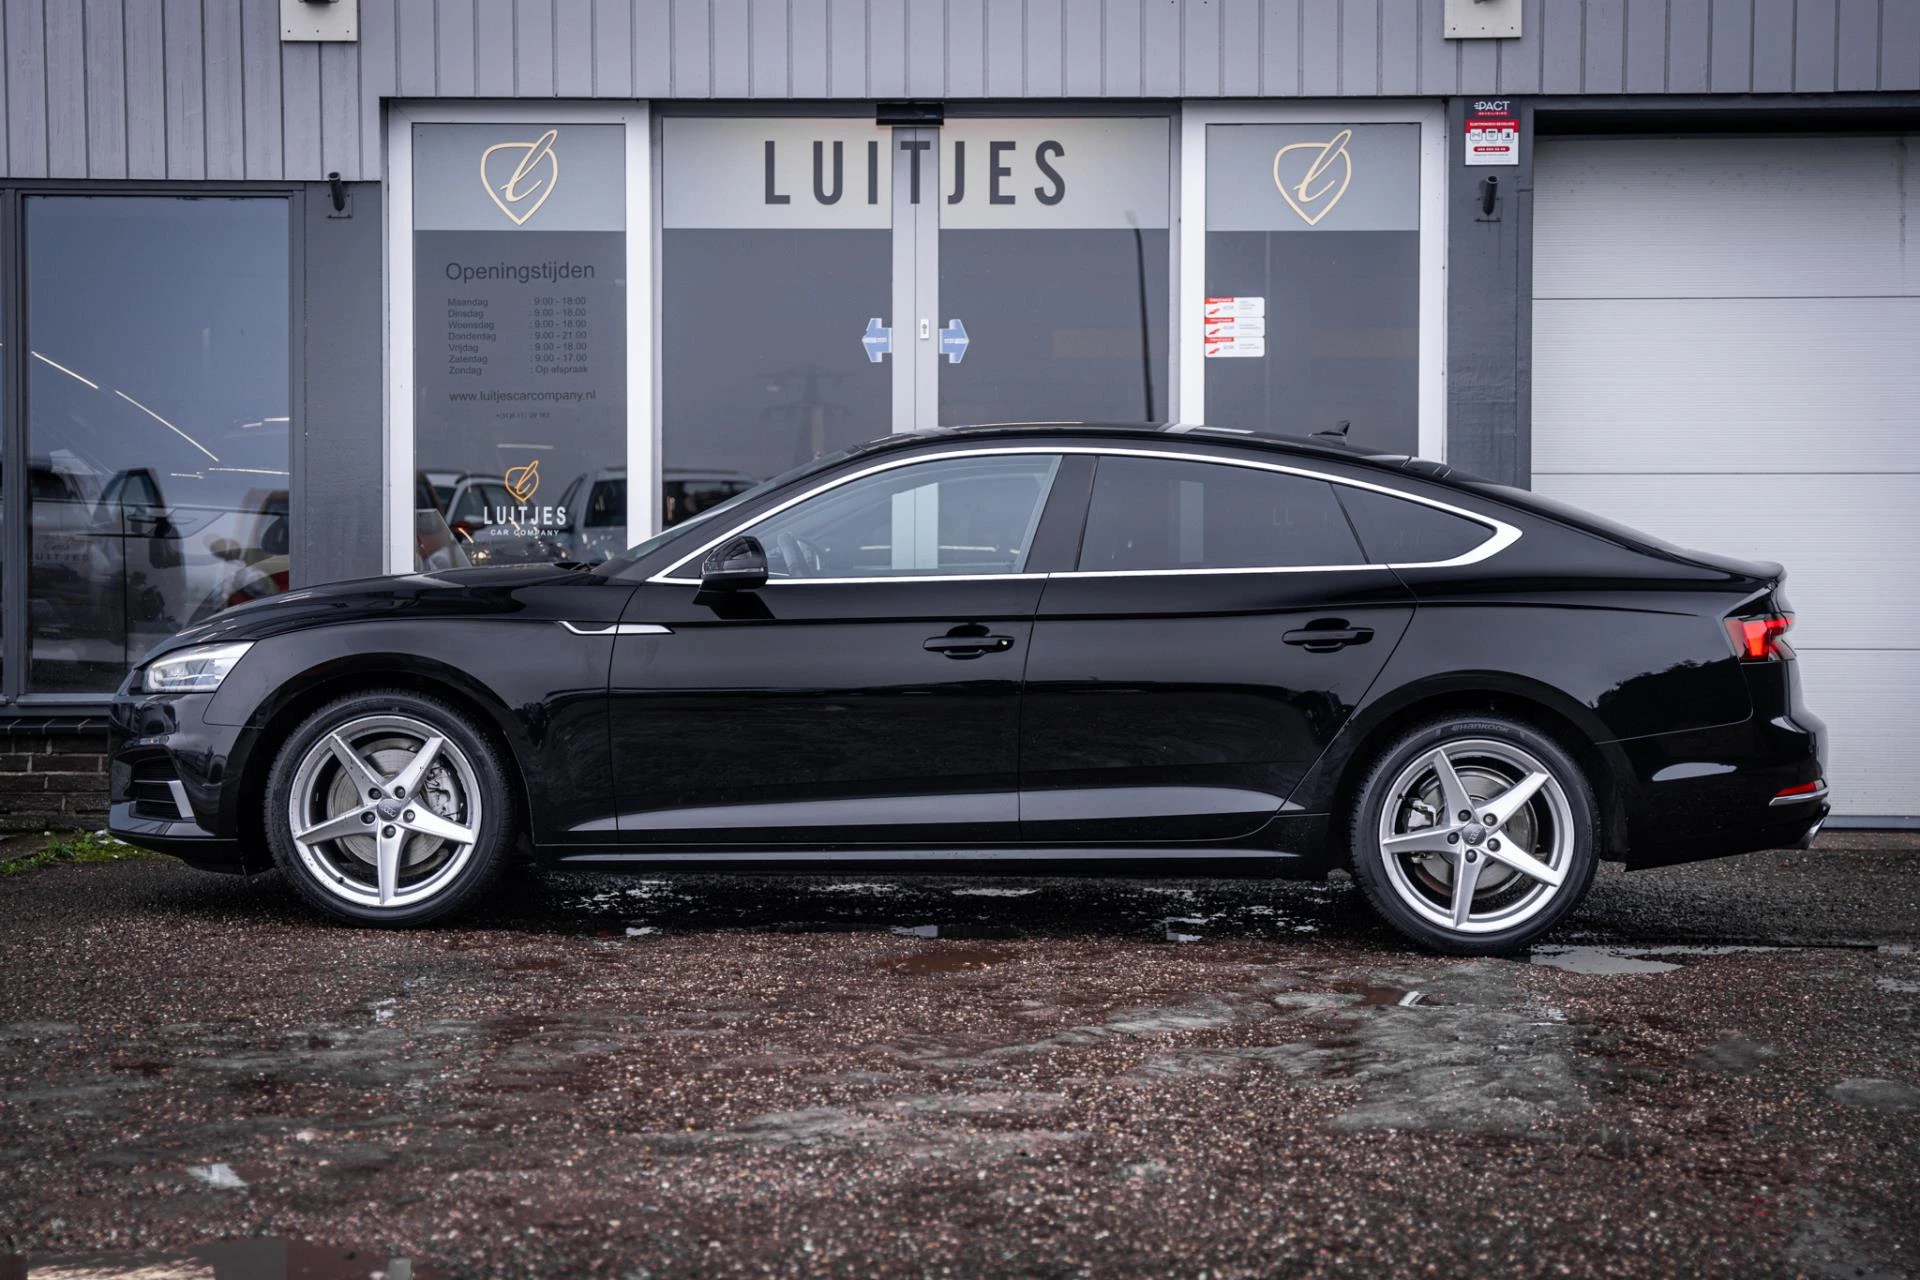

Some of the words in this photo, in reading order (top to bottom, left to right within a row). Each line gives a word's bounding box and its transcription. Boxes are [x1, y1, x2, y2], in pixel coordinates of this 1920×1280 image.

[764, 140, 1066, 206] LUITJES
[446, 261, 595, 284] Openingstijden
[447, 298, 489, 308] Maandag
[448, 309, 484, 319] Dinsdag
[448, 320, 495, 331] Woensdag
[448, 332, 497, 342] Donderdag
[448, 343, 479, 353] Vrijdag
[448, 354, 488, 365] Zaterdag
[448, 366, 482, 376] Zondag
[535, 365, 549, 375] Op
[448, 389, 596, 404] www.luitjescarcompany.nl
[483, 505, 566, 525] LUITJES
[513, 529, 560, 537] COMPANY
